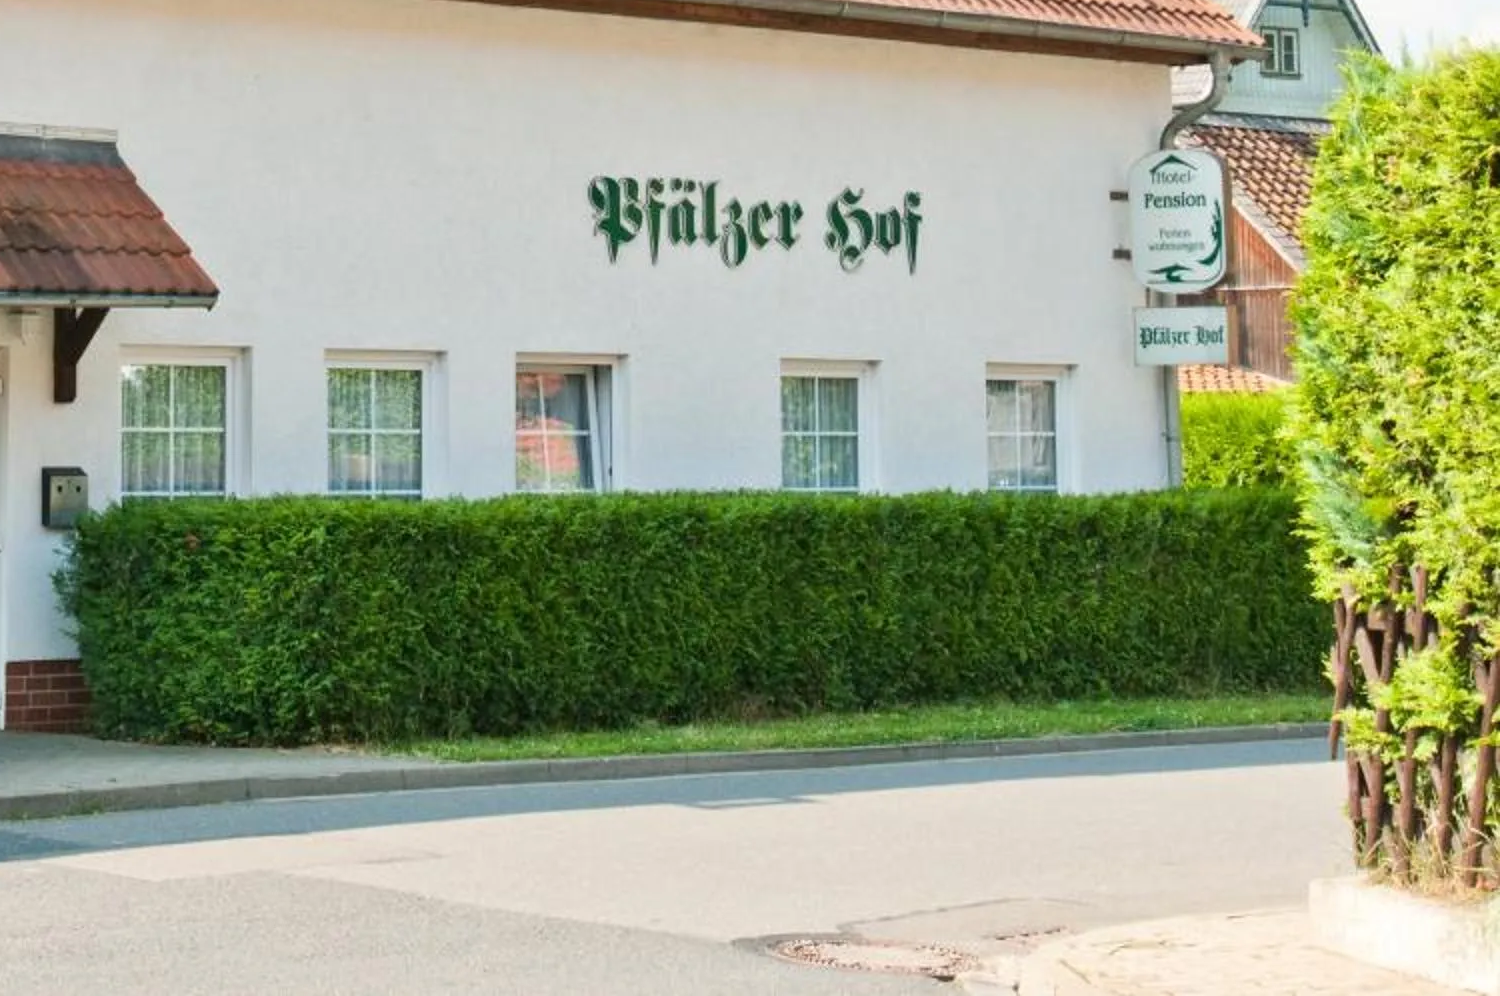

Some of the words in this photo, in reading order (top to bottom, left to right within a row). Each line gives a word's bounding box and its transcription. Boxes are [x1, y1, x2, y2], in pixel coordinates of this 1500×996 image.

[1143, 191, 1207, 209] Pension
[588, 175, 804, 269] Pfälzer
[825, 187, 923, 276] Hof
[1139, 325, 1191, 349] Pfälzer
[1195, 325, 1224, 346] Hof
